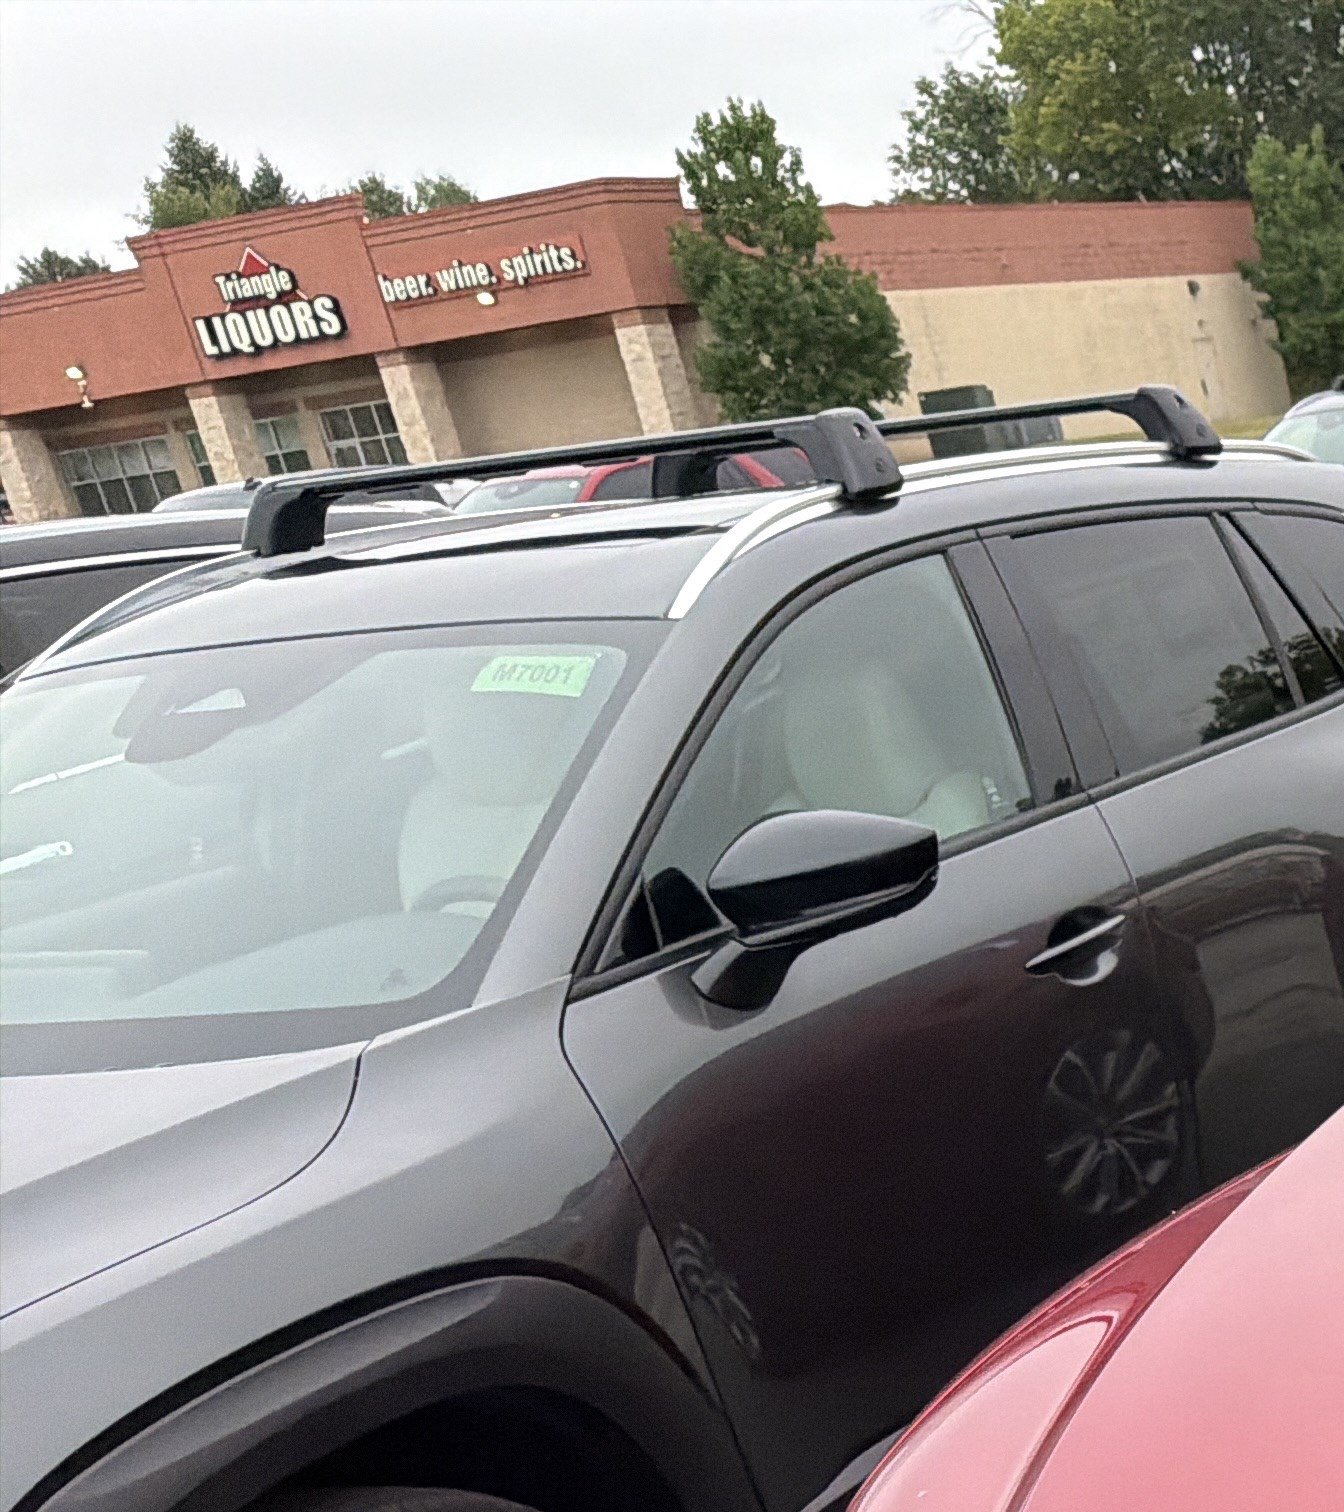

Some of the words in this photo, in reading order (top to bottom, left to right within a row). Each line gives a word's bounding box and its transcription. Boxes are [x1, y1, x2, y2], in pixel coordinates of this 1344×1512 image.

[214, 265, 293, 300] Triangle
[377, 273, 433, 302] beer.
[435, 259, 497, 291] wine.
[500, 243, 583, 285] spirits.
[195, 296, 341, 355] LIQUORS
[492, 663, 574, 684] M7001
